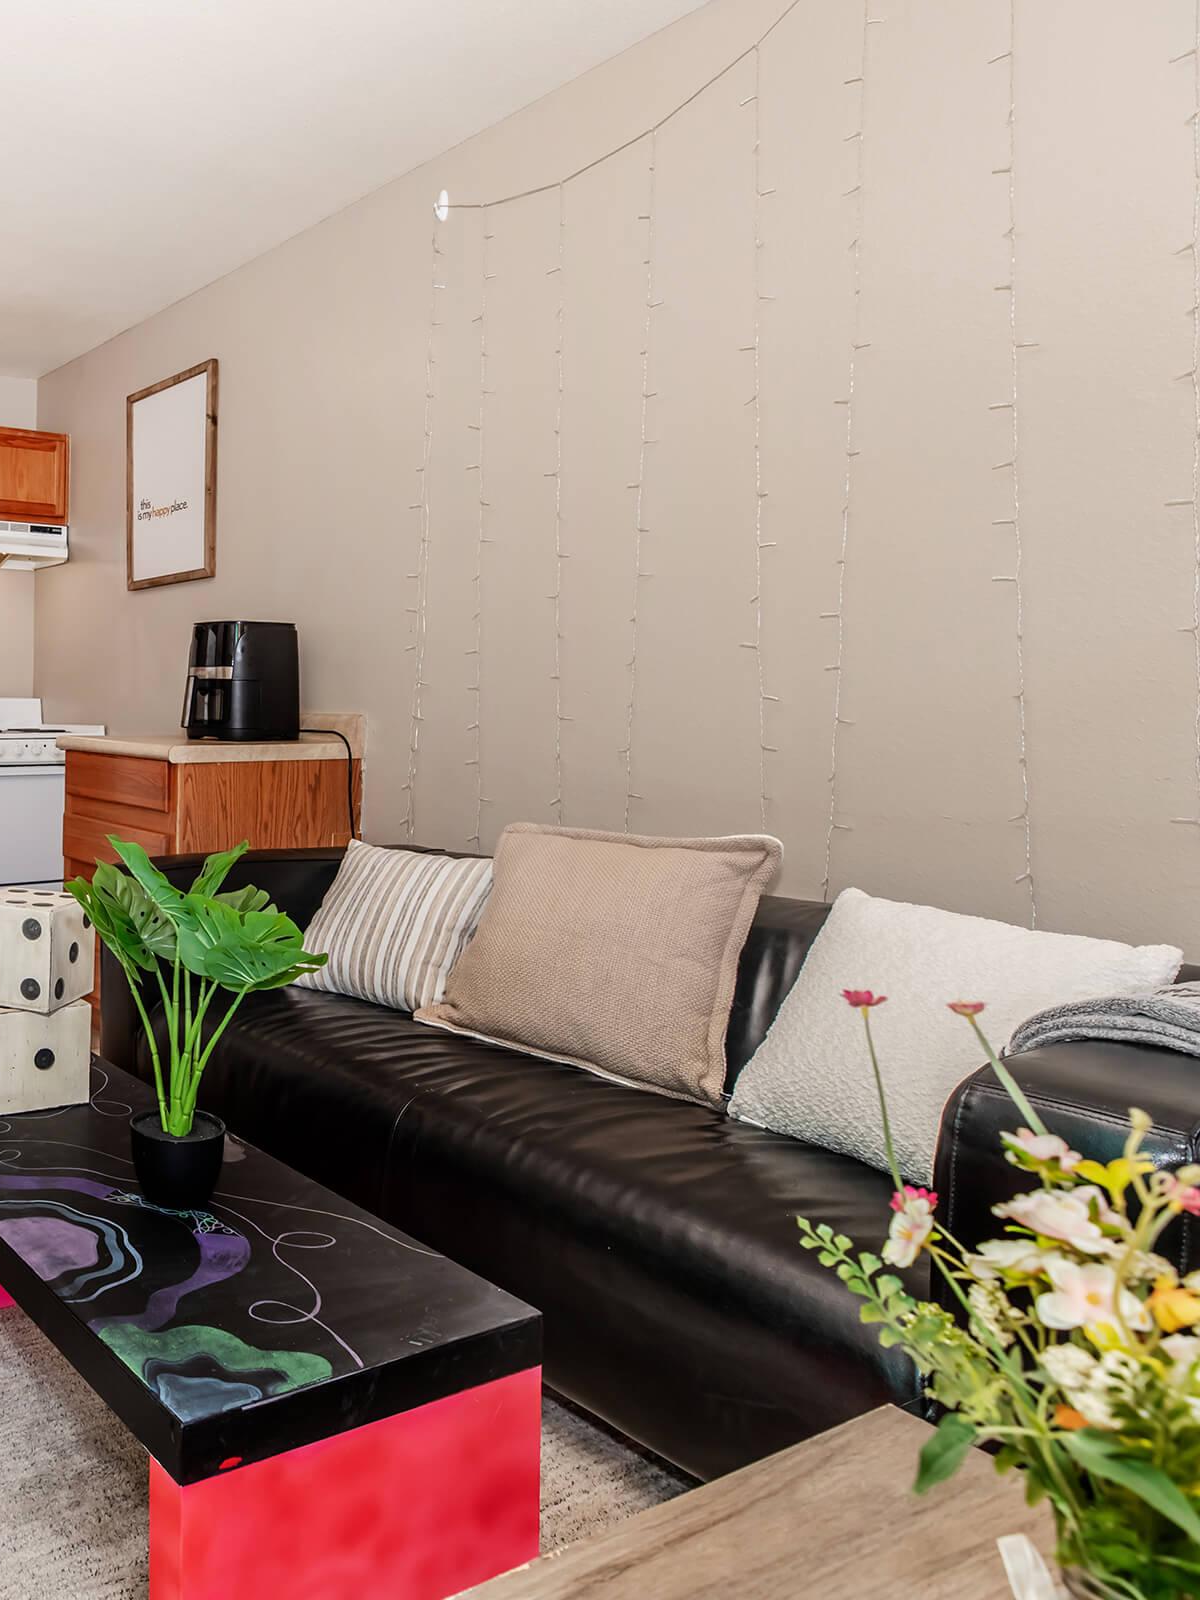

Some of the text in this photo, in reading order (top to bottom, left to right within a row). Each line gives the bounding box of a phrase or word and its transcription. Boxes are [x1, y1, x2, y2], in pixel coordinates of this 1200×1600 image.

[140, 498, 151, 511] this
[143, 511, 151, 521] my
[152, 506, 169, 519] happy
